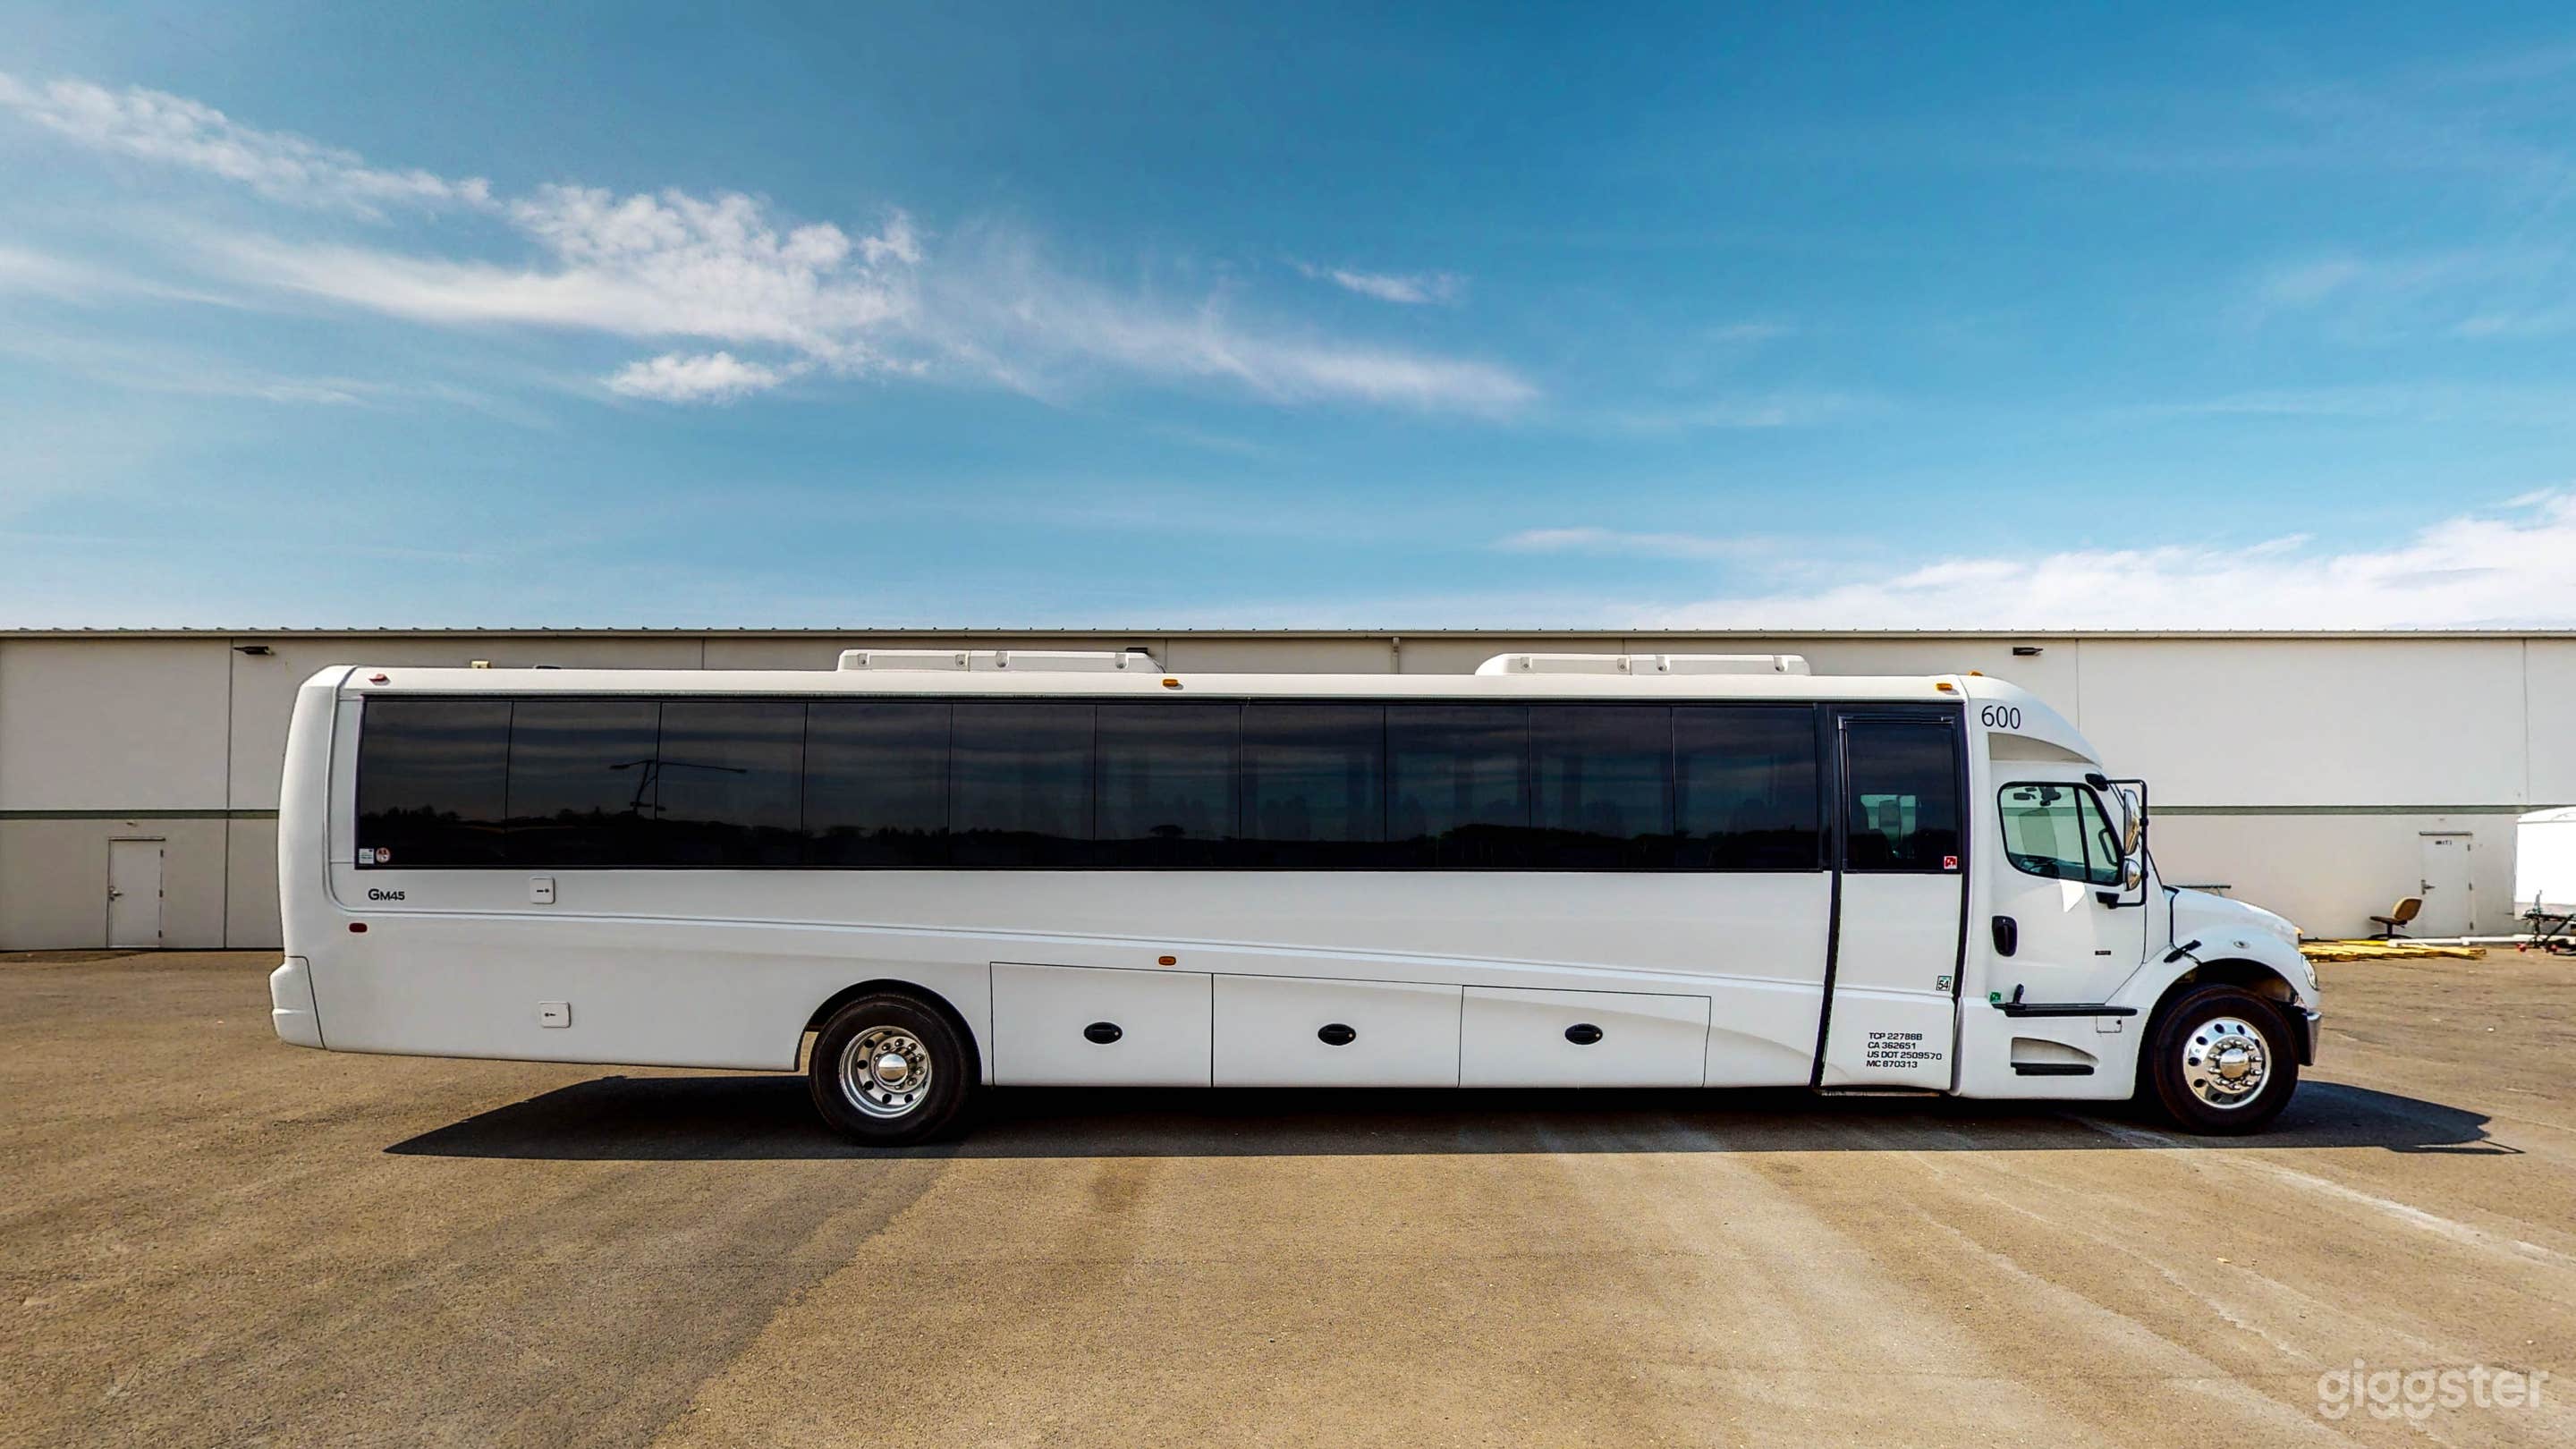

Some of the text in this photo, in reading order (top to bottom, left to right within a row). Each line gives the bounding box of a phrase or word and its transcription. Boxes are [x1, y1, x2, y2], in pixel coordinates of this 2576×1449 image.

[1981, 705, 2021, 730] 600
[368, 888, 405, 901] GM45
[1937, 979, 1949, 990] 54
[1868, 1031, 1886, 1039] TCP
[1867, 1041, 1917, 1050] CA 362651
[1867, 1050, 1943, 1061] US DOT 2509570
[1883, 1060, 1919, 1069] 870313
